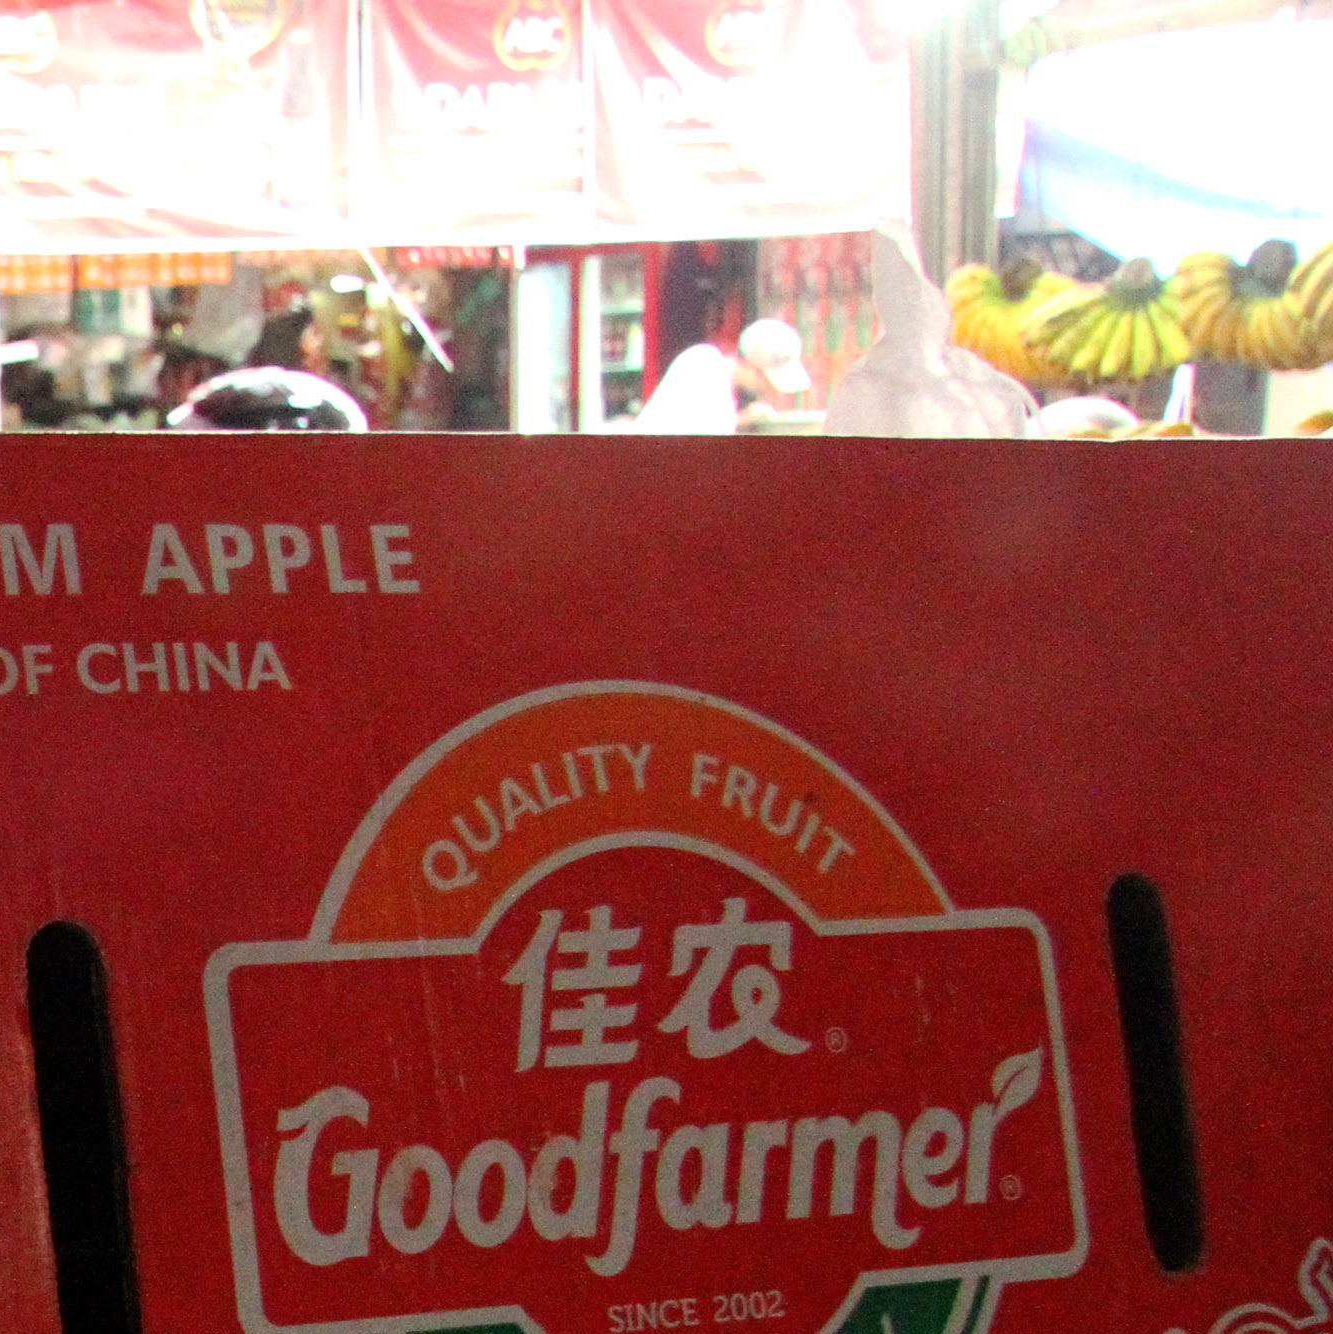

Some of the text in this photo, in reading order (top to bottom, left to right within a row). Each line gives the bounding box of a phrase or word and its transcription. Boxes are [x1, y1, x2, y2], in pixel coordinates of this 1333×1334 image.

[140, 522, 421, 596] APPLE
[75, 640, 294, 694] CHINA
[420, 742, 857, 892] QUALITY FRUIT
[502, 897, 813, 1074] 佳农
[273, 1048, 1043, 1277] Goodfarmer
[607, 1289, 787, 1334] SINCE 2002
